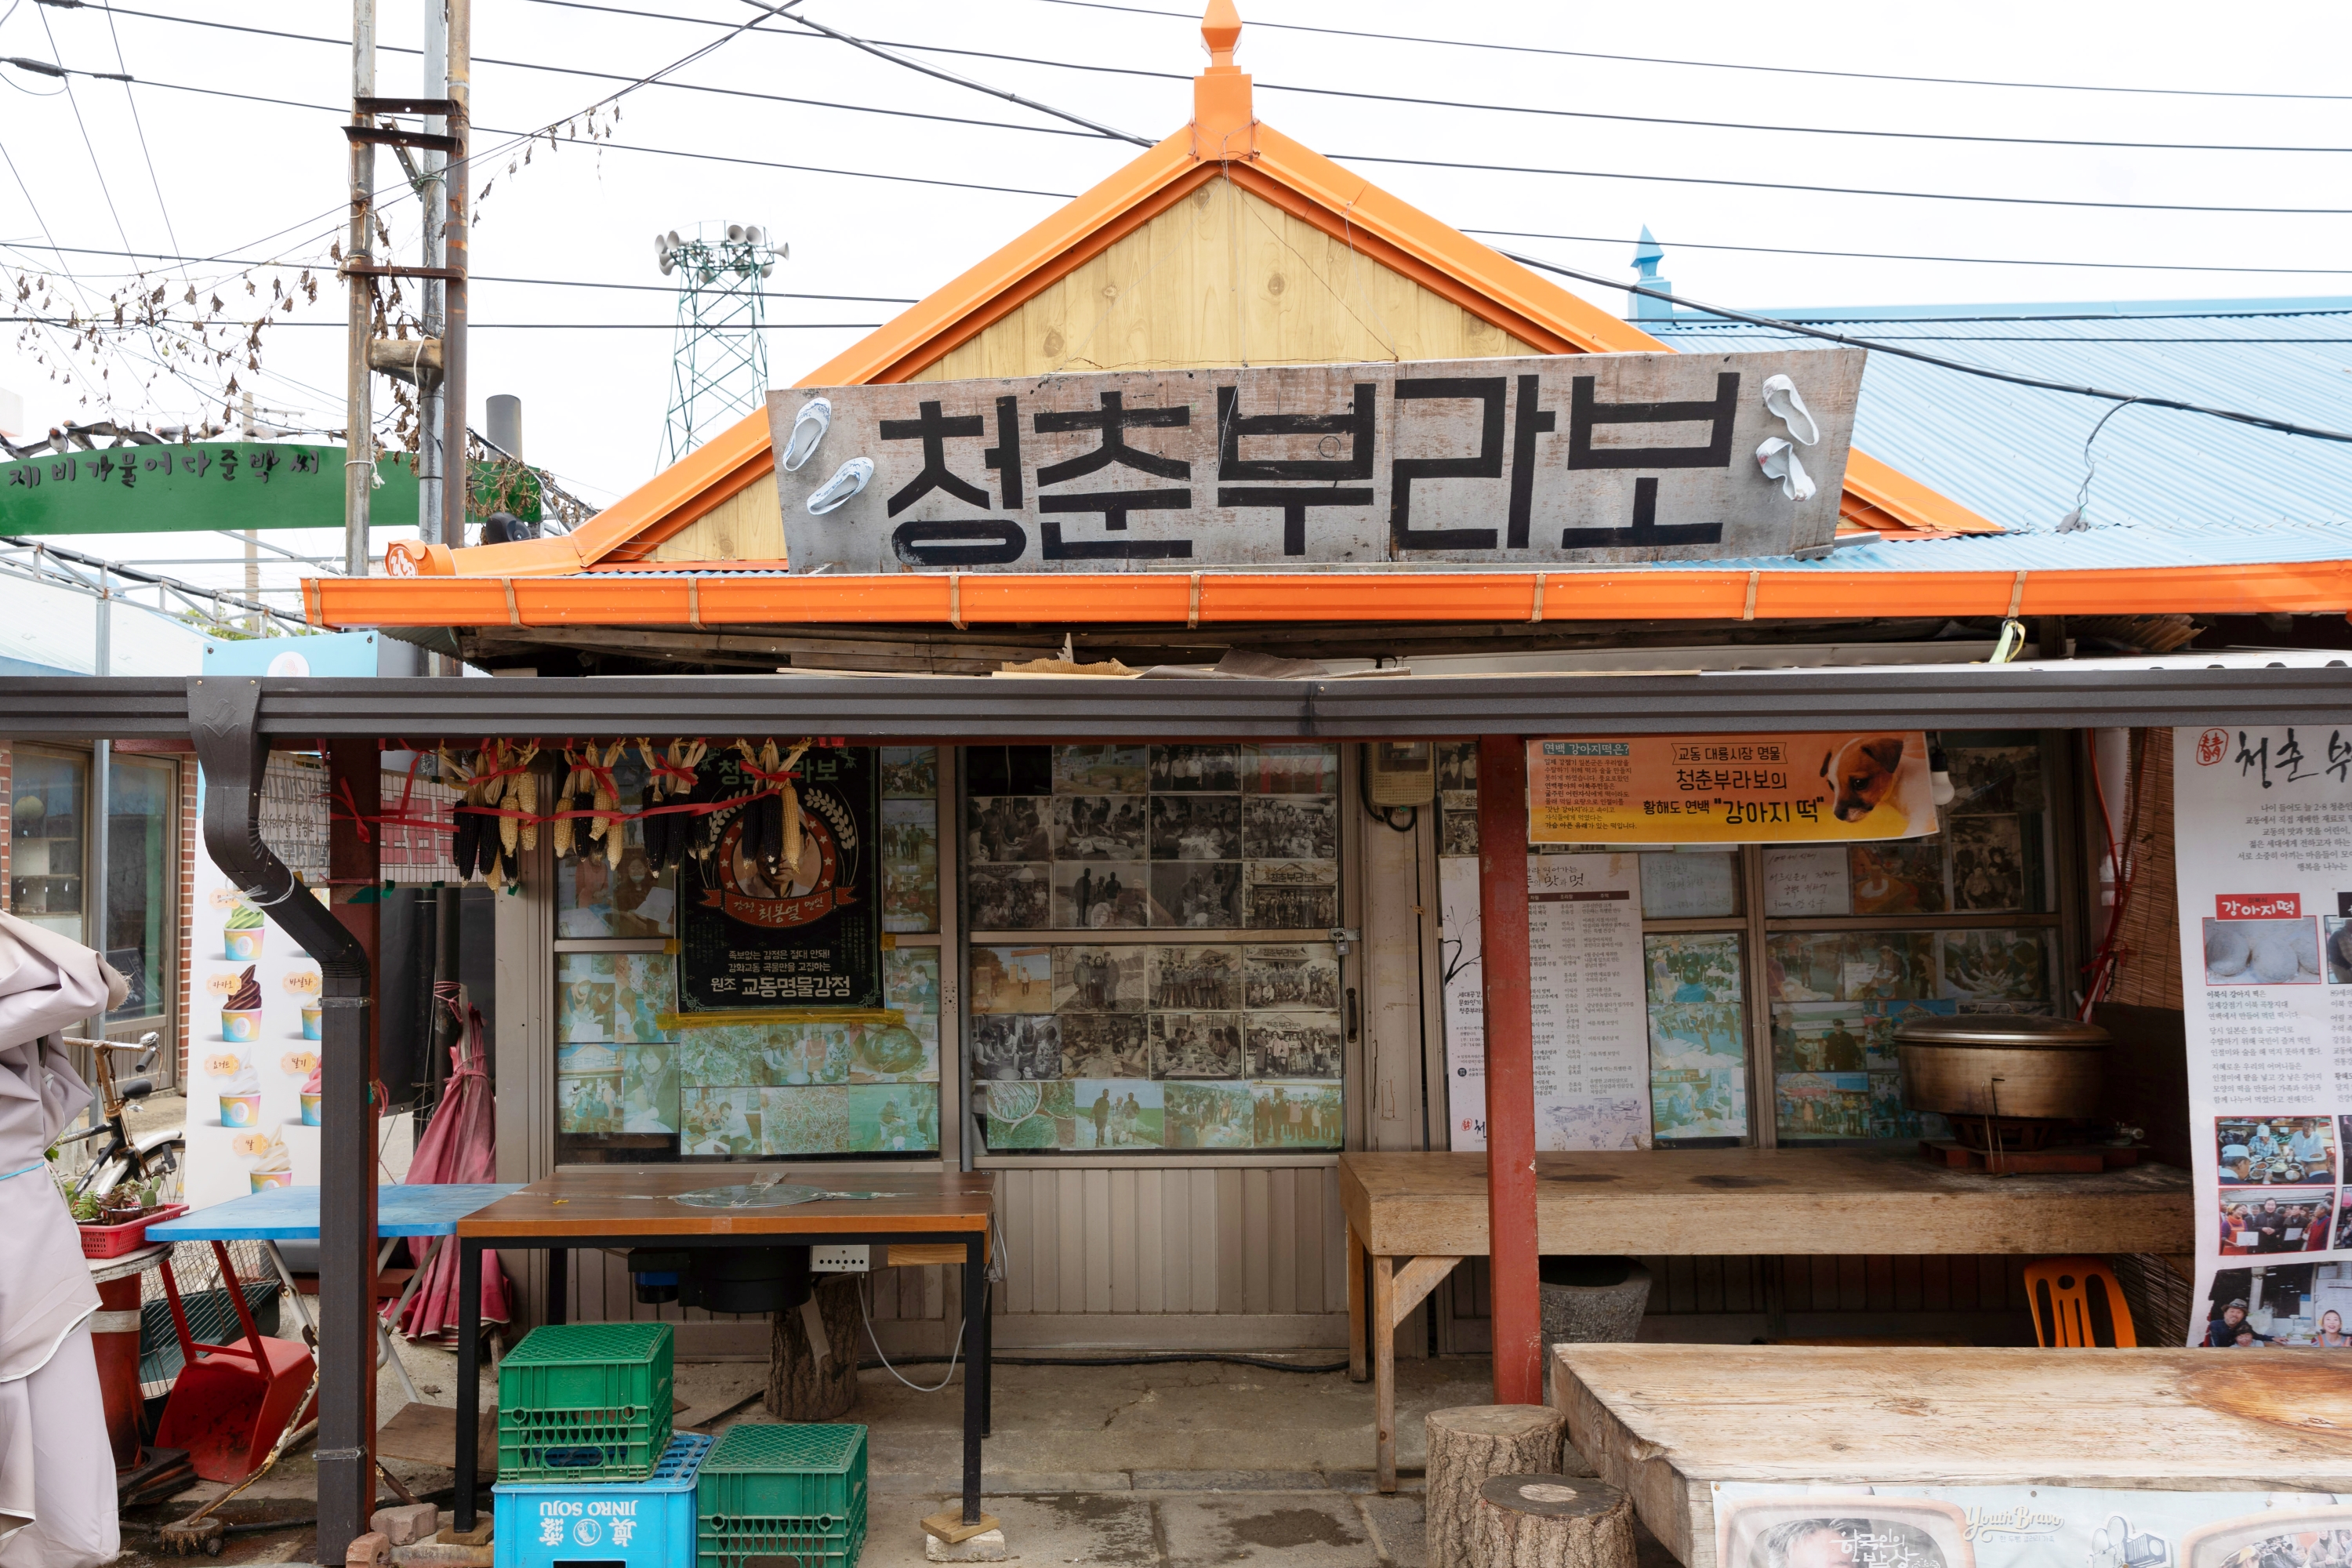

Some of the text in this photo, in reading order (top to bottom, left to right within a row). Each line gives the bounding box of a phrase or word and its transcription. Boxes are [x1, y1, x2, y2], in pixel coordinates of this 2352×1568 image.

[879, 370, 1741, 568] 청춘부라보
[1544, 742, 1629, 756] 연백 강아지떡은?
[1678, 746, 1780, 761] 교동 대룡시장 명물
[1676, 769, 1788, 791] 청춘부라보의
[1642, 800, 1682, 815] 황해도
[1685, 799, 1710, 815] 연백
[2260, 804, 2277, 812] 나이
[2278, 803, 2303, 812] 들어도
[2303, 803, 2312, 812] 늘
[2245, 815, 2347, 826] 교동에서 직접 재배한 재료로
[2262, 827, 2286, 837] 교동의
[2287, 827, 2303, 836] 맛과
[2305, 826, 2321, 836] 멋을
[2249, 838, 2350, 848] 젊은 세대에게 전하고자 하는
[2238, 851, 2253, 861] 서로
[2255, 851, 2278, 861] 소중히
[2280, 851, 2304, 860] 아끼는
[2305, 850, 2338, 859] 마음들이
[2296, 862, 2348, 872] 행복을 나누는
[758, 902, 804, 924] 최봉열
[2221, 900, 2295, 916] 강아지떡
[728, 950, 761, 960] 족보없는
[763, 949, 789, 960] 강정은
[789, 949, 808, 960] 절대
[728, 962, 832, 973] 강화교동 곡물만을 고집하는
[710, 975, 851, 997] 원조 교동명물강정
[2206, 989, 2227, 998] 이북식
[2229, 989, 2250, 998] 강아지
[539, 1499, 639, 1516] JINRO SOJU
